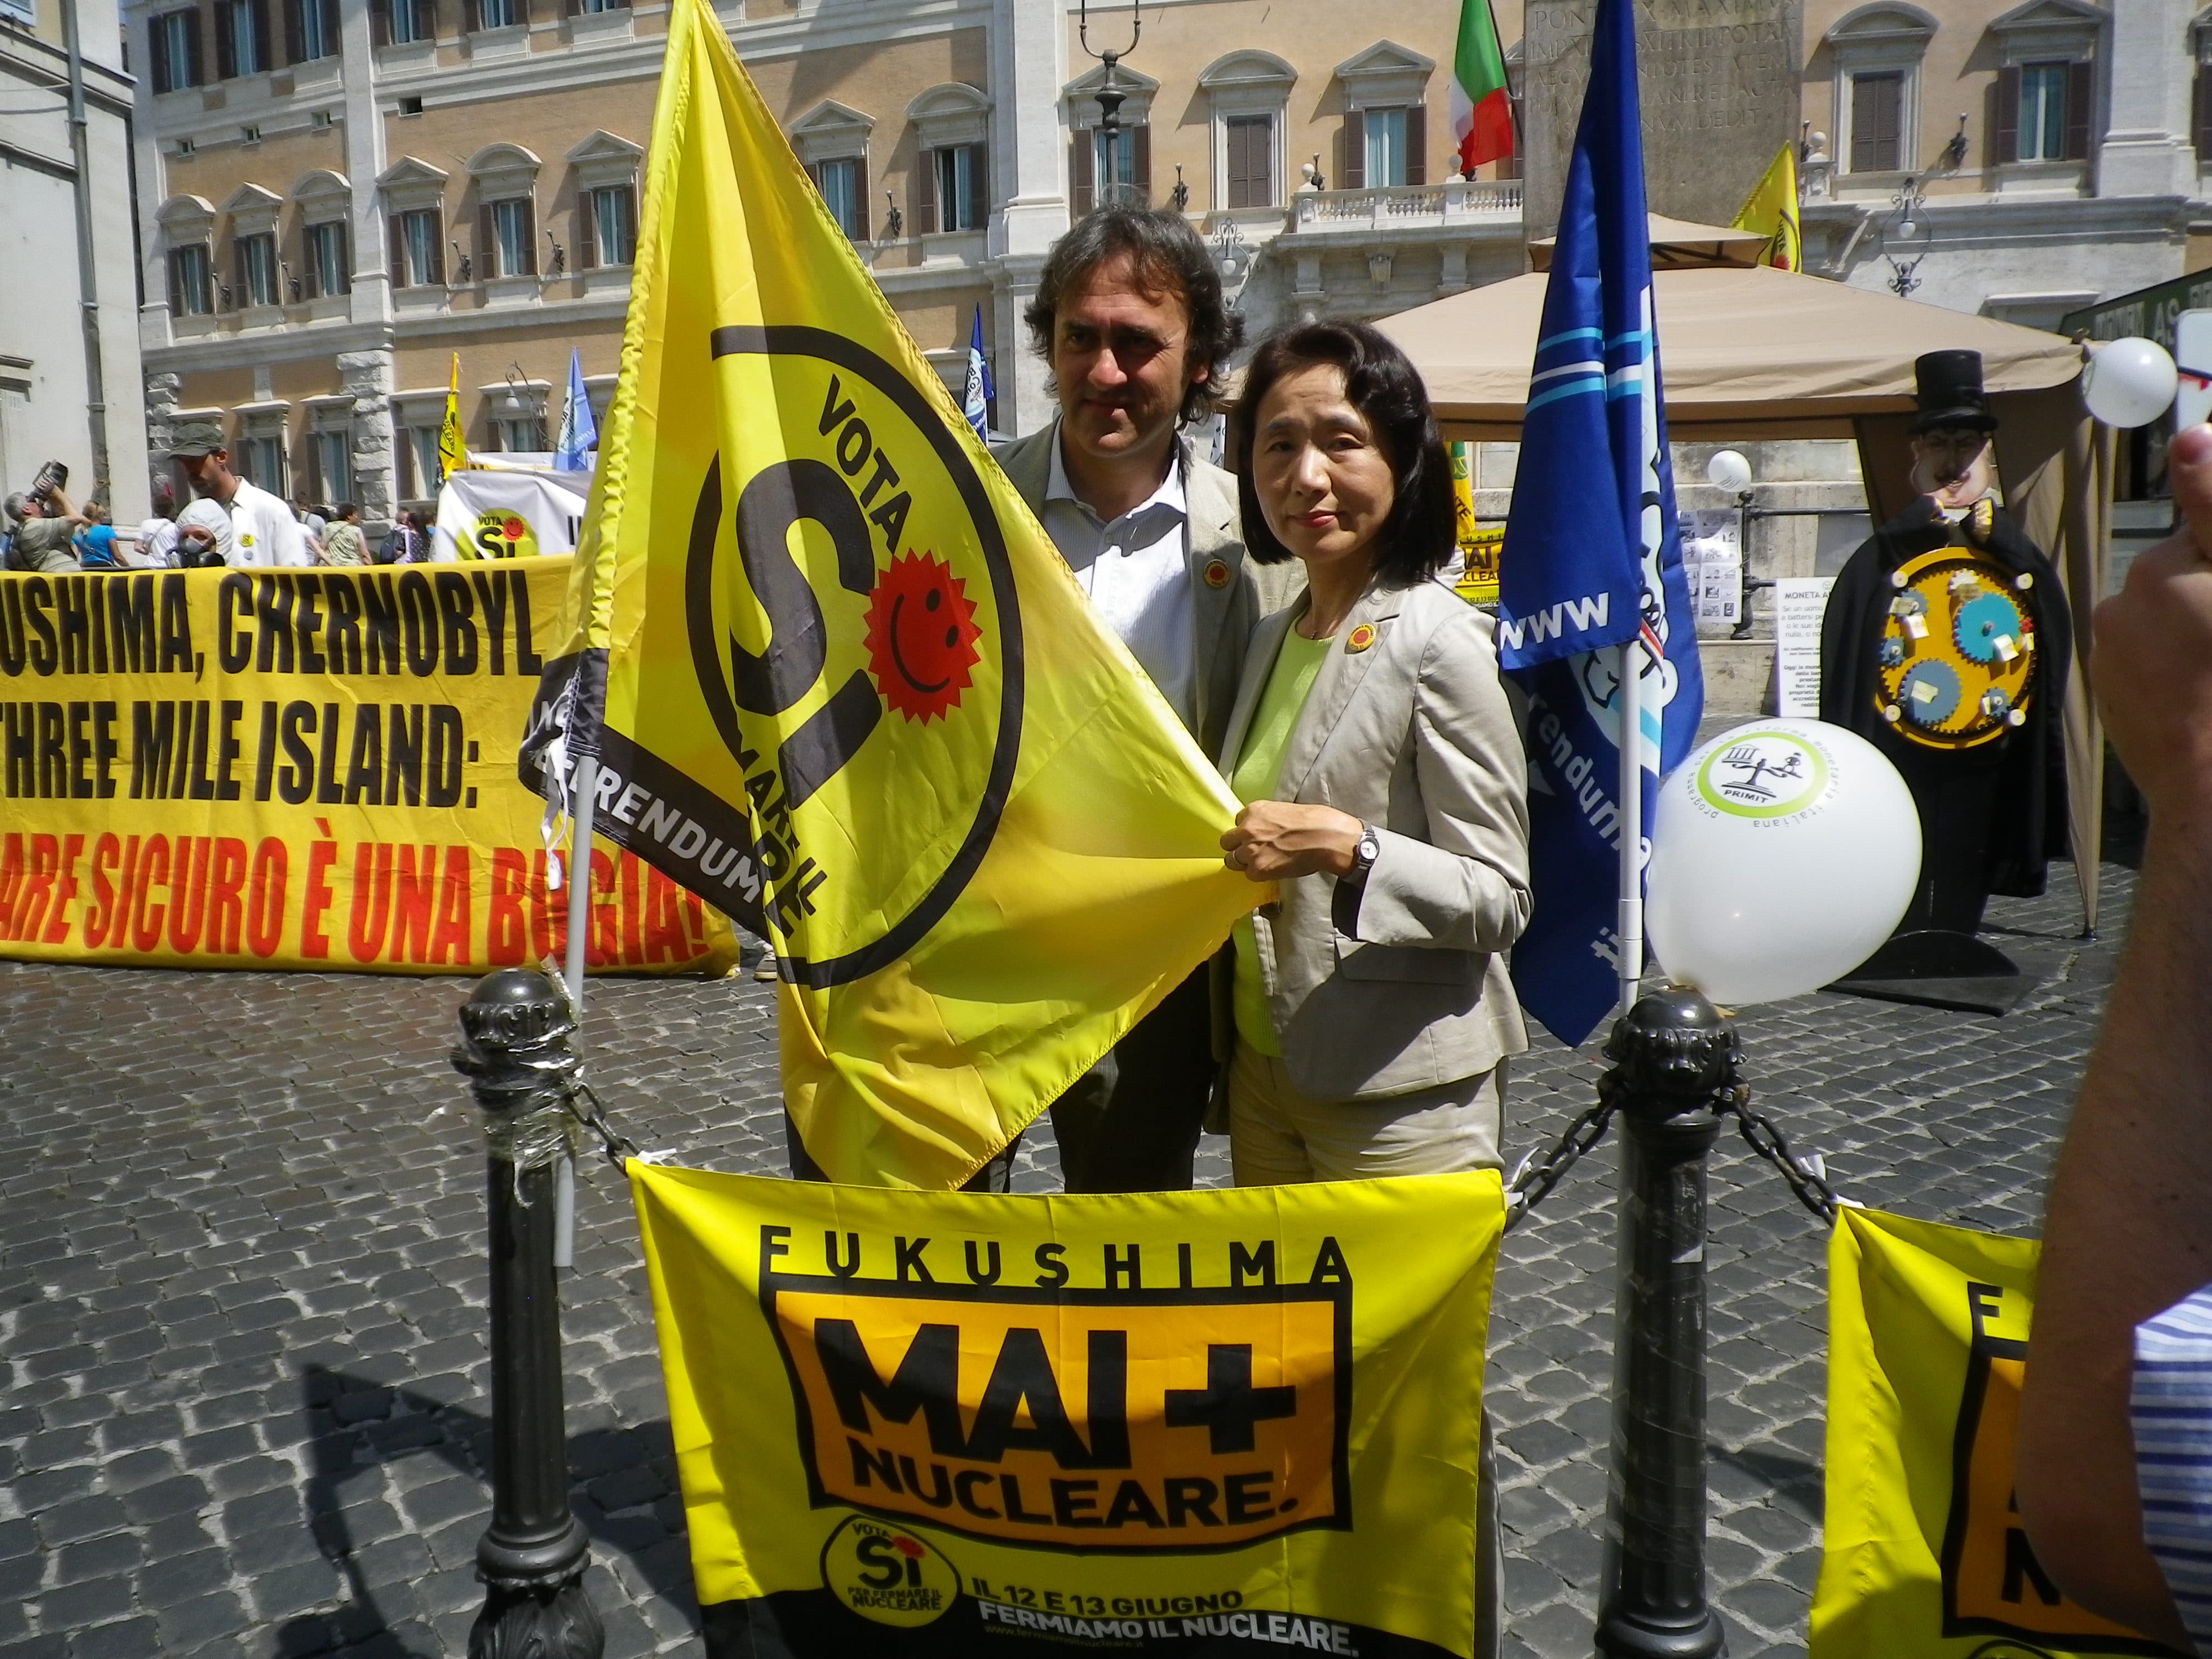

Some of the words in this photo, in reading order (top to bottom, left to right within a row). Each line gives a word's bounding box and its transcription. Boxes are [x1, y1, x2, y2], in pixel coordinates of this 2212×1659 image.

[818, 373, 912, 555] VOTA
[478, 517, 502, 526] VOTA
[218, 569, 542, 677] CHERNOBYL
[0, 701, 117, 799] HREE
[129, 700, 243, 801] MILE
[254, 700, 478, 808] ISLAND:
[1724, 789, 1768, 804] PRIMIT
[83, 832, 288, 958] SICURO
[300, 817, 337, 959] È
[347, 841, 470, 966] UNA
[760, 1224, 1352, 1291] FUKUSHIMA
[813, 1317, 1132, 1470] MAI
[846, 1436, 1300, 1530] NUCLEARE.
[852, 1523, 891, 1539] VOTA
[852, 1595, 942, 1611] NUCLEARE
[971, 1577, 1001, 1601] IL
[1004, 1585, 1036, 1608] 12
[1043, 1592, 1067, 1613] E
[1070, 1594, 1107, 1616] 13
[1111, 1590, 1244, 1616] GIUGNO
[978, 1600, 1144, 1639] FERMIAMO
[1149, 1621, 1180, 1639] IL
[1183, 1613, 1360, 1658] NUCLEARE.
